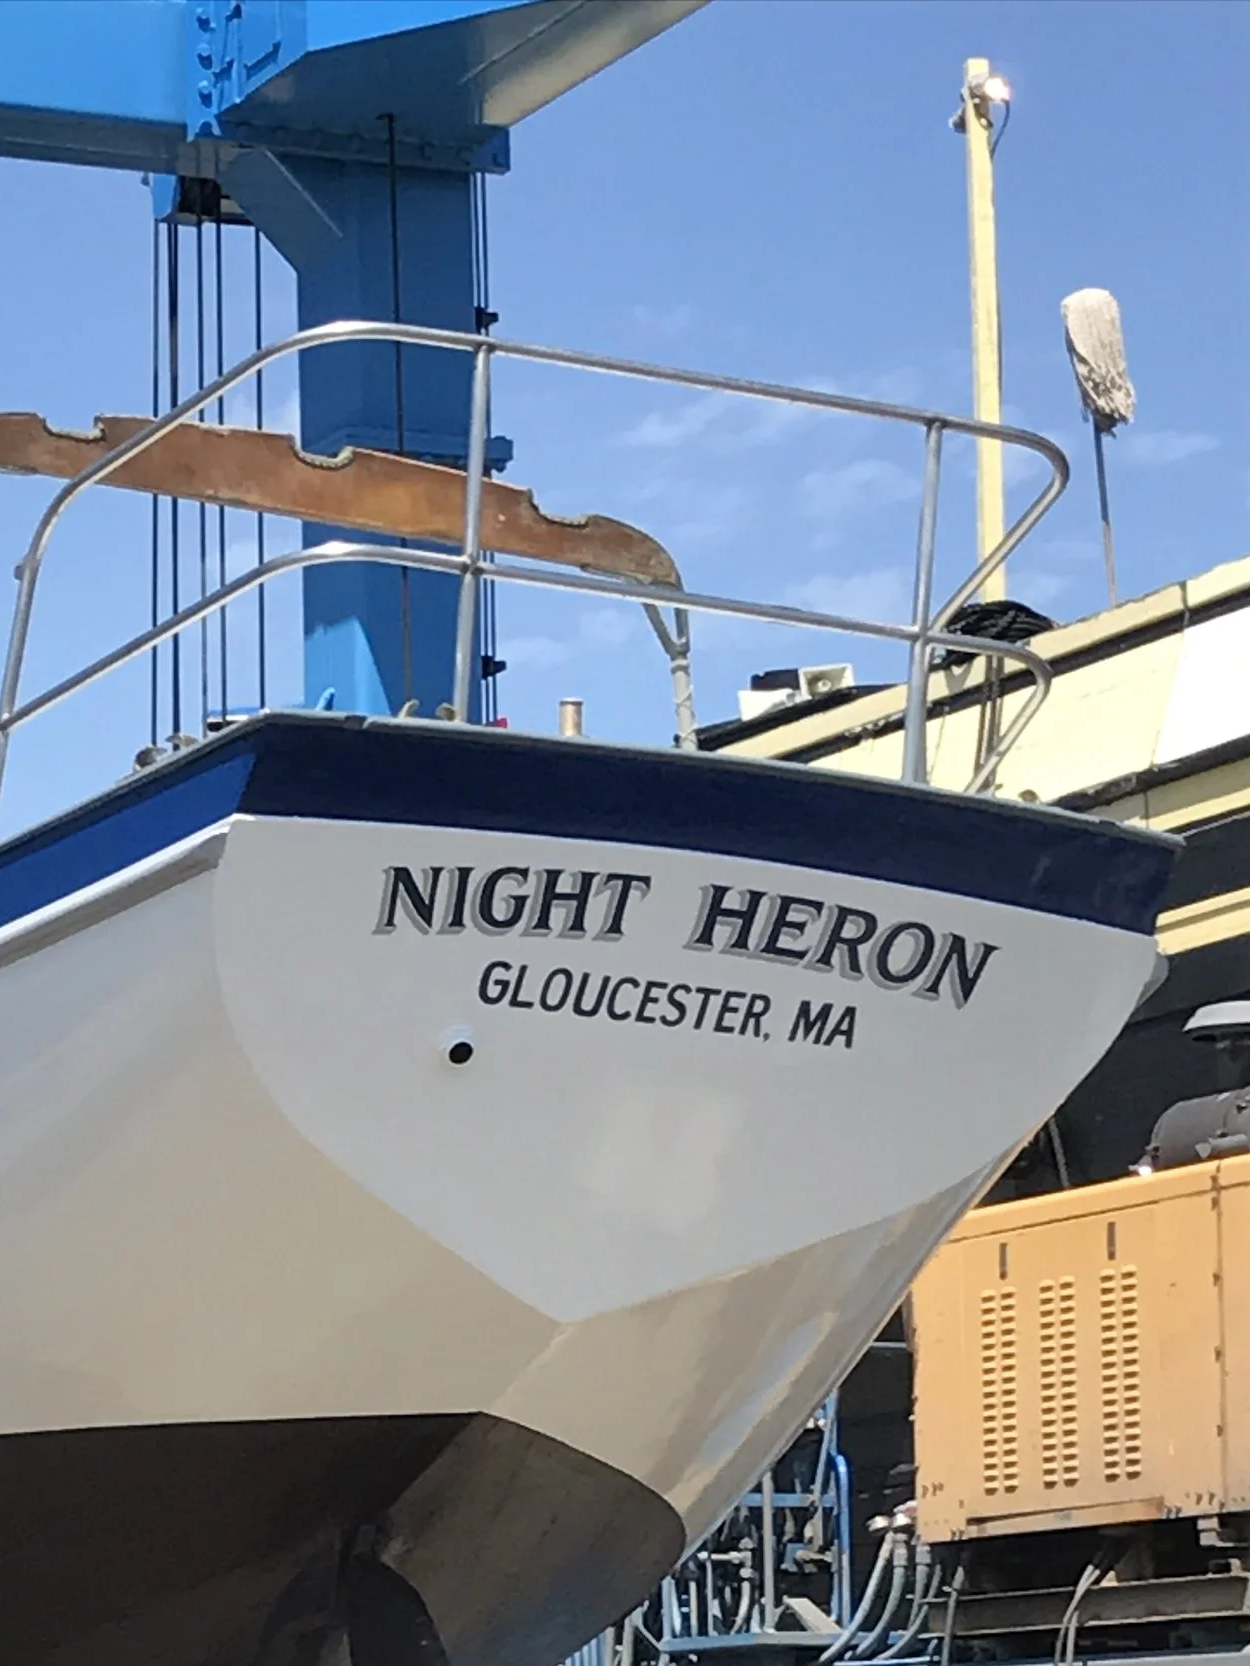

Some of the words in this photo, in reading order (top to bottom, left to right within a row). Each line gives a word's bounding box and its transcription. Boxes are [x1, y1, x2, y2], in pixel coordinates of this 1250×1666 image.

[371, 865, 651, 939] NIGHT
[684, 885, 1000, 1010] HERON
[478, 960, 771, 1041] GLOUCESTER,
[788, 1000, 858, 1049] MA
